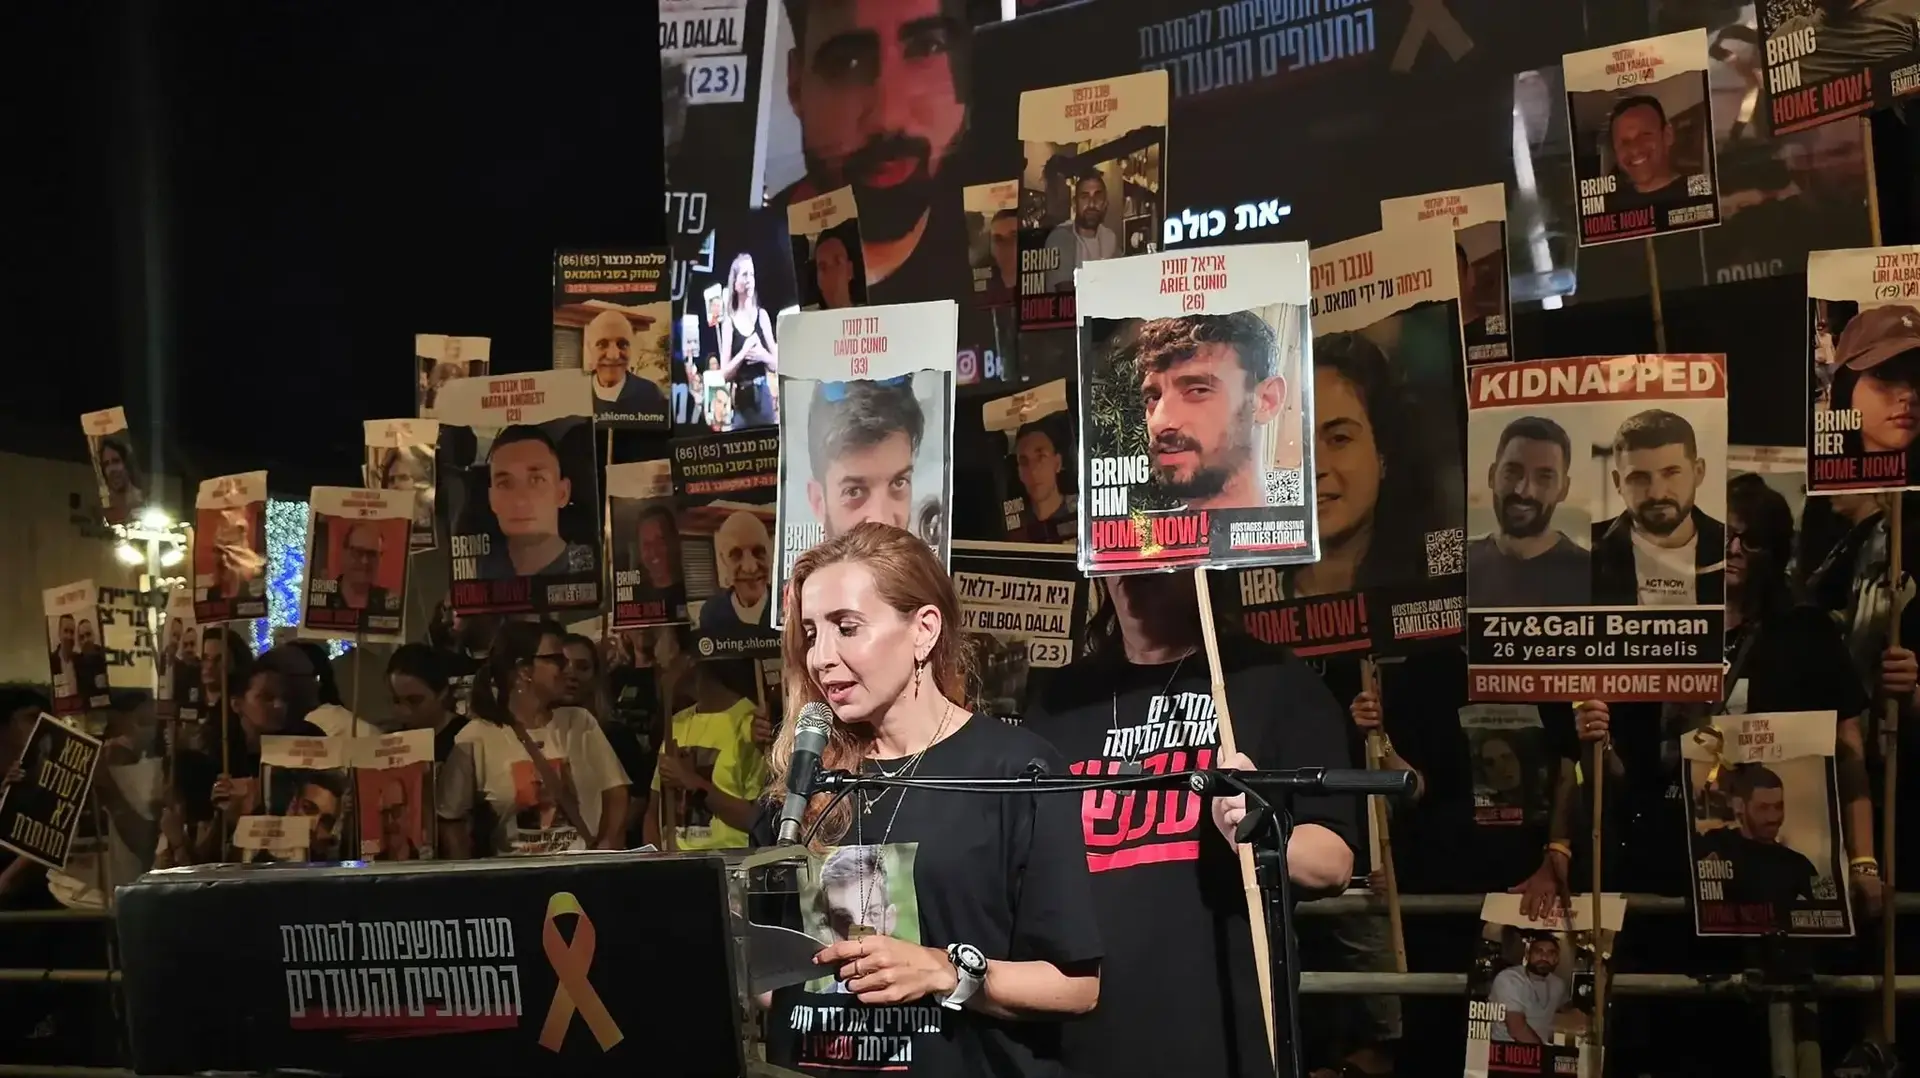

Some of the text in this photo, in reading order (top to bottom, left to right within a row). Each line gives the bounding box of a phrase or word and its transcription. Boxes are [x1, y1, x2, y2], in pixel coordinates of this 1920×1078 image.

[683, 17, 737, 48] DALAL
[1141, 8, 1376, 98] החטופים והנעדר
[1765, 26, 1817, 66] BRING
[688, 63, 740, 98] (23)
[1768, 60, 1801, 95] HIM
[1891, 73, 1920, 97] FAMILIE
[1772, 67, 1873, 124] HOME NOW!
[1581, 175, 1617, 198] BRING
[1582, 195, 1605, 216] HIM
[1164, 207, 1226, 244] כולם
[1584, 213, 1617, 236] HOME
[1619, 206, 1655, 230] NOW!
[634, 253, 666, 265] שלמה
[1021, 247, 1060, 272] BRING
[1161, 254, 1226, 276] אריאל קוניו
[1311, 250, 1374, 291] ענבר הימ
[1021, 272, 1046, 296] HIM
[1159, 274, 1228, 294] ARIEL CUNIO
[1873, 269, 1890, 284] LIRI
[1182, 293, 1206, 312] (26)
[1321, 268, 1433, 315] נרצחה על ידי חמאס.
[1875, 284, 1900, 300] (19)
[1021, 296, 1076, 321] HOME NO
[833, 336, 888, 356] DAVID CUNIO
[850, 356, 868, 376] (33)
[1479, 362, 1716, 402] KIDNAPPED
[1814, 409, 1862, 432] BRING
[723, 441, 756, 455] מנצור
[1814, 432, 1844, 456] HER
[682, 457, 777, 477] חזק בשבי החמאס
[1091, 455, 1150, 488] BRING
[1814, 452, 1906, 481] HOME NOW!
[1091, 486, 1128, 517] HIM
[785, 524, 825, 551] BRING
[1151, 511, 1209, 546] NOW!
[1230, 519, 1305, 533] HOSTAGES AND MISSING
[1230, 528, 1305, 546] FAMILIES FORUM
[451, 533, 491, 556] BRING
[453, 558, 476, 580] HIM
[616, 570, 641, 587] BRING
[1046, 586, 1069, 605] גיא
[1239, 567, 1280, 606] HER
[1244, 592, 1369, 644] HOME NOW!
[1391, 601, 1428, 617] HOSTAGES
[1443, 595, 1467, 610] MISS
[979, 611, 1022, 631] GILBOA
[1025, 614, 1066, 633] DALAL
[1393, 609, 1465, 635] FAMILIES FOR
[1483, 615, 1709, 638] Ziv&Gali Berman
[716, 637, 783, 652] bring.shlomo
[1029, 643, 1068, 665] (23)
[1492, 641, 1698, 661] 26 years old Israelis
[1475, 673, 1718, 694] BRING THEM HOME NOW!
[59, 738, 94, 775] אמא
[50, 799, 75, 830] לא
[1697, 860, 1734, 880] BRING
[1700, 880, 1724, 901] HIM
[280, 917, 515, 963] מטה המשפחות להחזרת
[285, 965, 523, 1018] החטופים והנעדרים
[818, 1006, 845, 1032] דוד
[848, 1007, 870, 1032] את
[874, 1006, 942, 1033] מחזירים
[1469, 1000, 1506, 1021] BRING
[1467, 1021, 1491, 1041] HIM
[857, 1035, 912, 1062] הביתה
